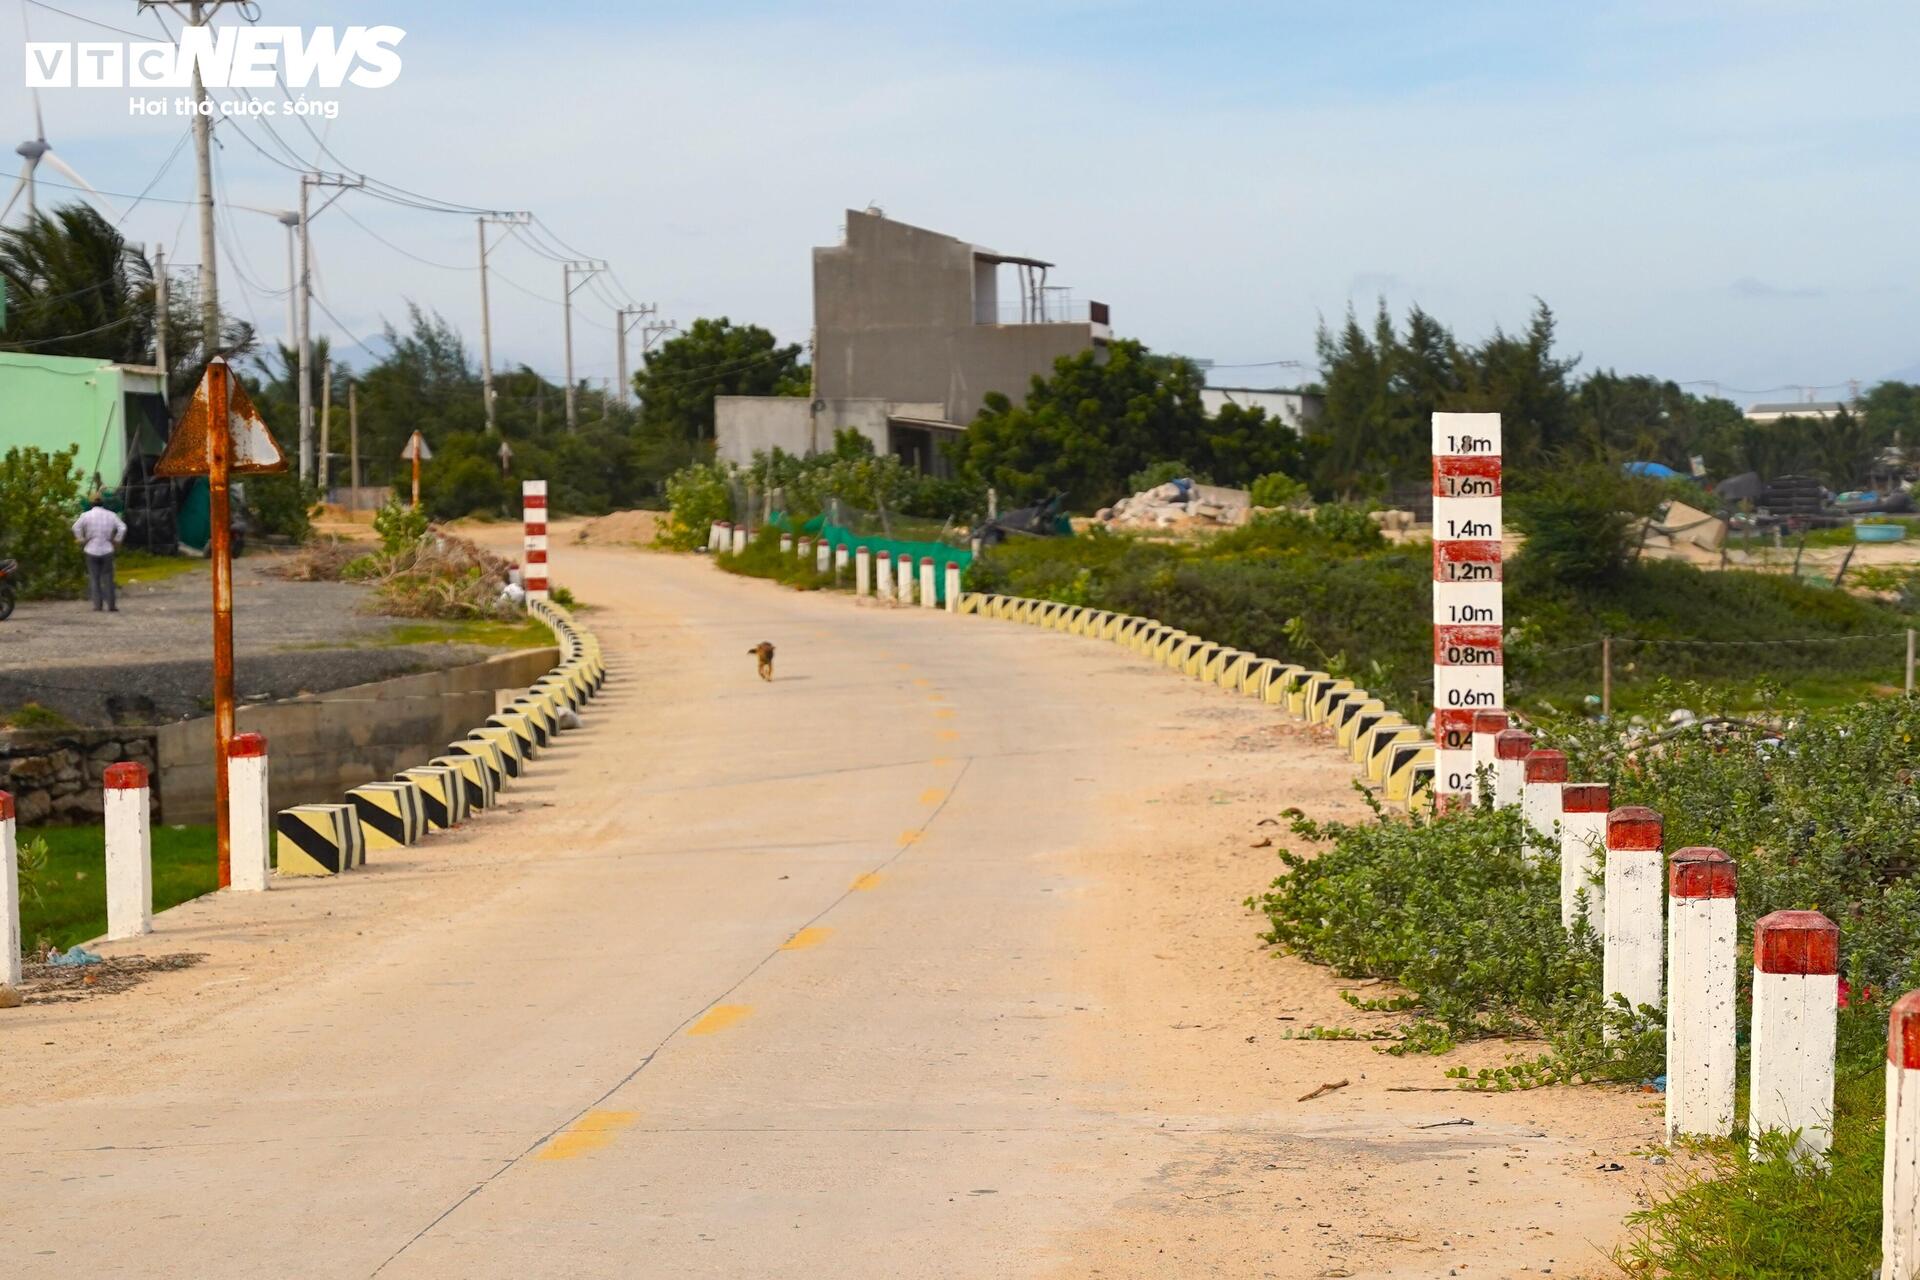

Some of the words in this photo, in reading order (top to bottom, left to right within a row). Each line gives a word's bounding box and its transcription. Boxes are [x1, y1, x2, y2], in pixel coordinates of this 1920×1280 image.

[1447, 435, 1492, 454] 1,8m
[1447, 477, 1493, 497] 1,6m
[1447, 519, 1493, 538] 1,4m
[1447, 562, 1493, 582] 1,2m
[1448, 605, 1494, 624] 1,0m
[1447, 646, 1496, 666] 0,8m
[1447, 688, 1496, 708] 0,6m
[1447, 730, 1473, 749] 0,4
[1448, 773, 1473, 791] 0,2
